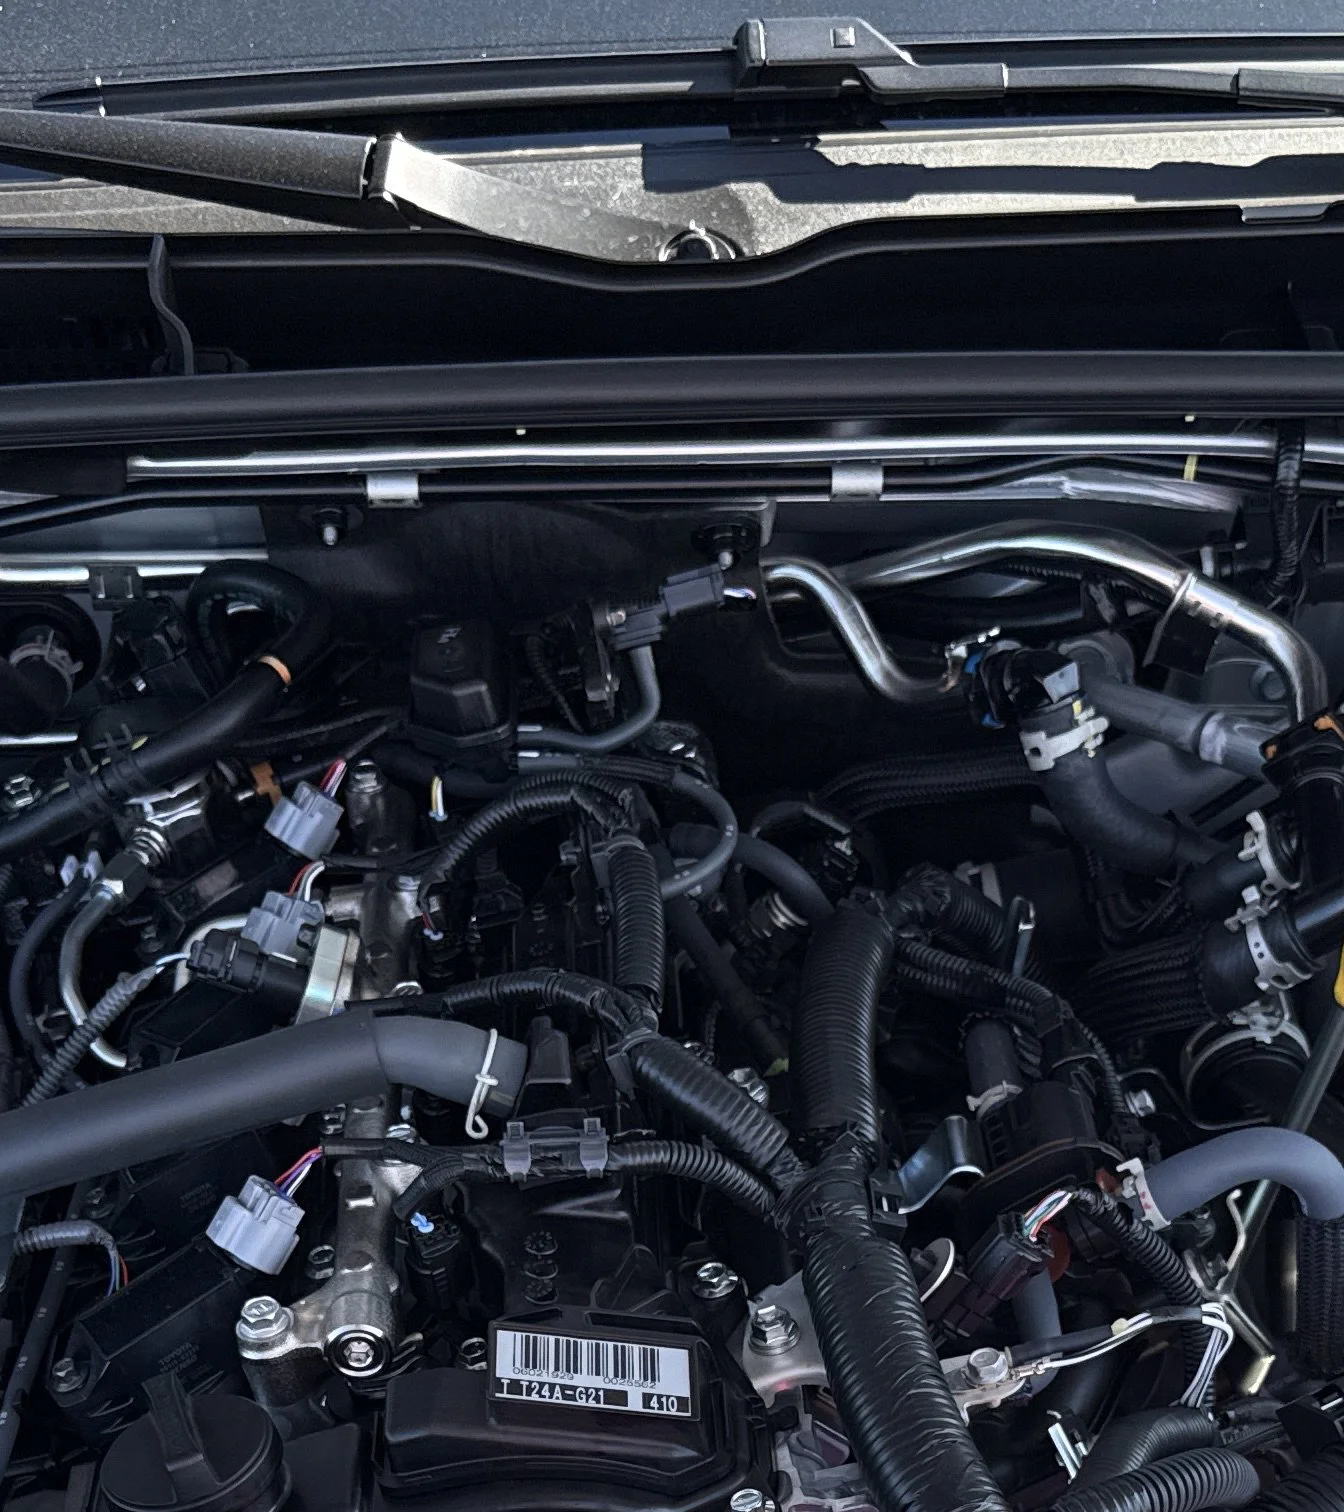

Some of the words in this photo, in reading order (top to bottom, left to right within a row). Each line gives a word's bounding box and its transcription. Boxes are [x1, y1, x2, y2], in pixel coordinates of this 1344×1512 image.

[501, 1379, 511, 1395] T
[520, 1381, 605, 1405] T24A-G21
[649, 1397, 678, 1412] 410
